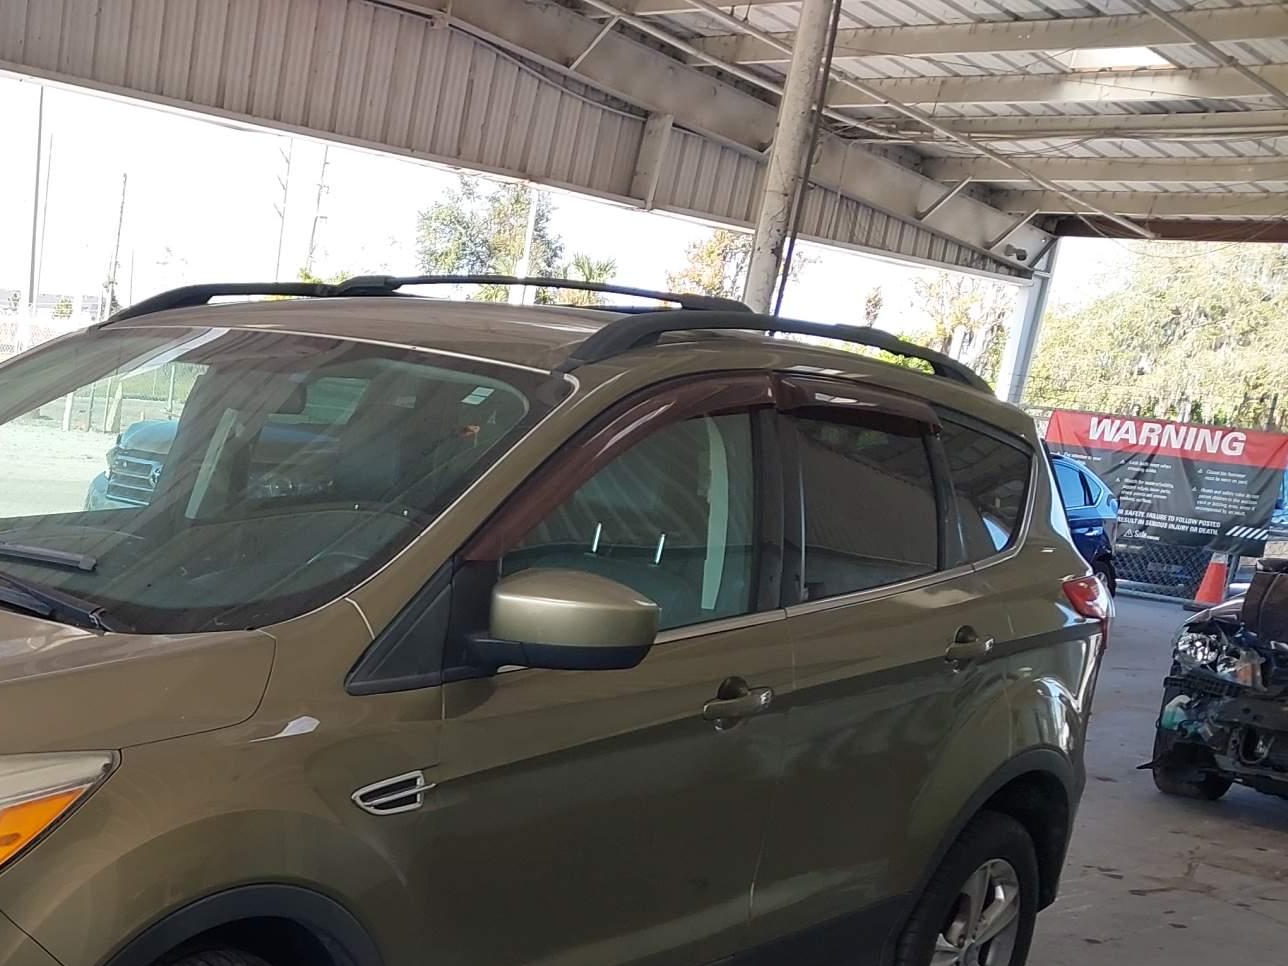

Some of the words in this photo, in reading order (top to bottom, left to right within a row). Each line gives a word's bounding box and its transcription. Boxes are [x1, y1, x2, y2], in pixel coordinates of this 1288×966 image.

[1088, 416, 1247, 456] WARNING
[1145, 520, 1168, 528] SERIOUS
[1168, 523, 1189, 531] INJURY
[1146, 512, 1168, 520] FAILURE
[1175, 516, 1198, 525] FOLLOW
[1198, 519, 1221, 528] POSTED
